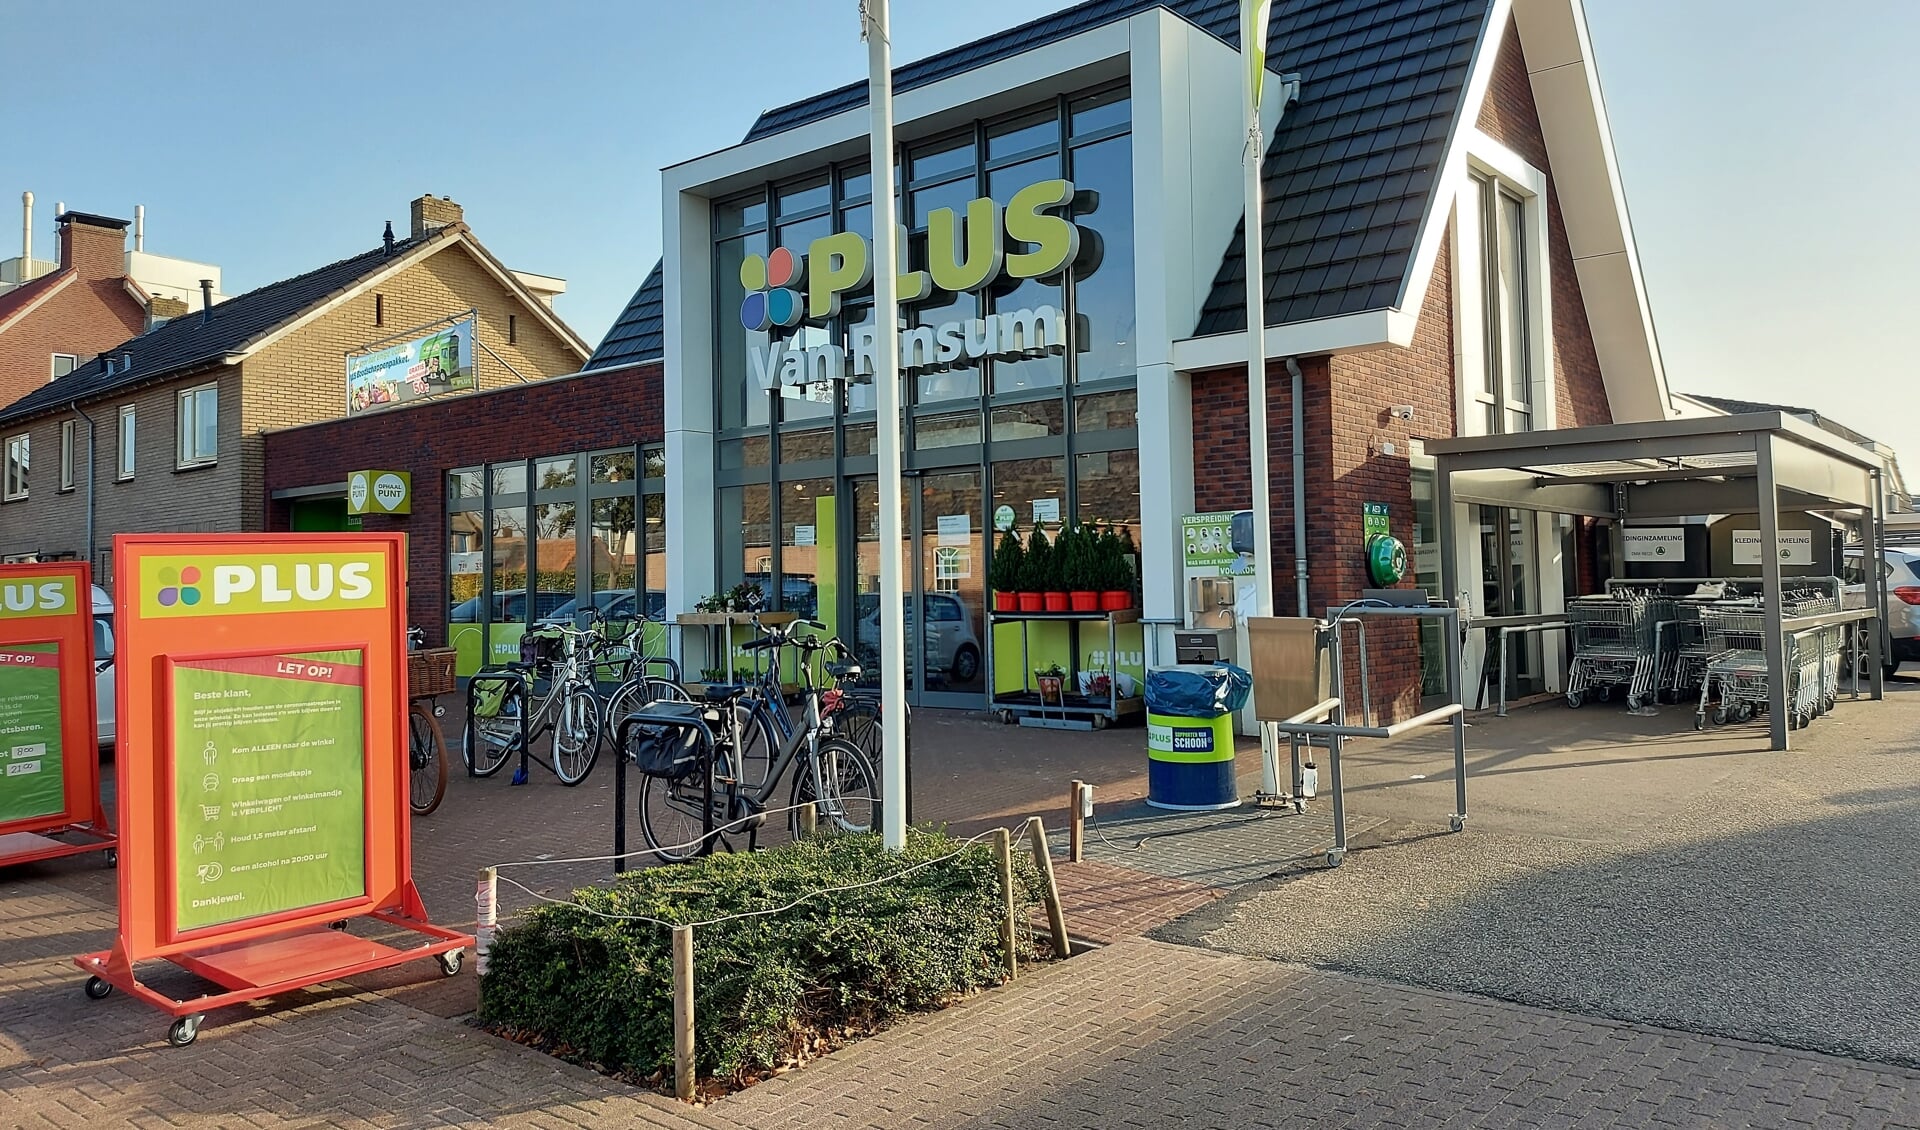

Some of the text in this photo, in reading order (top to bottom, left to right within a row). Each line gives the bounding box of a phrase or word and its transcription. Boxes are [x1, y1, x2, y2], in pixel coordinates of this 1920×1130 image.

[750, 304, 1066, 391] Van Rnsum
[378, 490, 402, 498] PUNT
[213, 561, 373, 605] PLUS
[0, 582, 66, 611] US
[501, 643, 520, 655] PLU
[737, 646, 768, 658] PLS
[0, 653, 36, 664] ET OP!
[1107, 650, 1143, 667] PLU
[277, 661, 333, 678] LET OP!
[193, 689, 251, 700] Beste klant,
[0, 723, 44, 734] etsbaren.
[251, 743, 282, 753] ALLEEN
[282, 742, 299, 750] naar
[300, 740, 311, 748] de
[311, 738, 335, 747] winkel
[1152, 733, 1171, 743] PLUS
[232, 775, 255, 784] Draag
[271, 768, 313, 779] mondkapje
[231, 796, 282, 809] Winkelwagen
[292, 789, 343, 801] winkelmandje
[239, 804, 283, 816] VERPLICHT
[230, 825, 317, 843] Houd 1,5 meter afstand
[230, 864, 251, 873] Geen
[251, 859, 280, 870] alcohol
[291, 854, 314, 864] 20:00
[315, 852, 329, 860] uur
[192, 892, 246, 908] Dankjewel.
